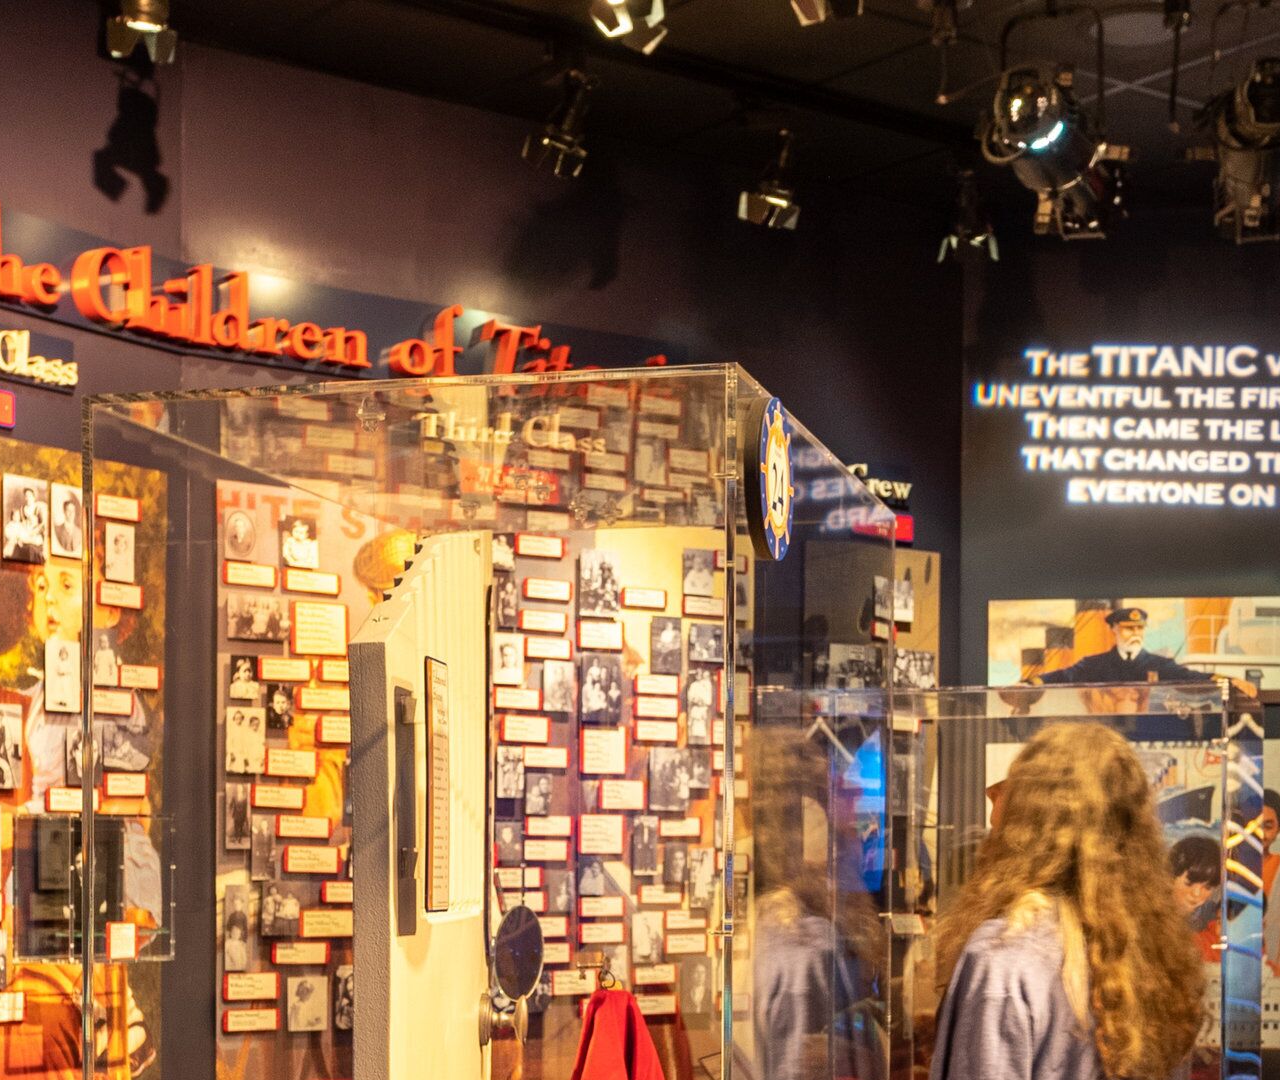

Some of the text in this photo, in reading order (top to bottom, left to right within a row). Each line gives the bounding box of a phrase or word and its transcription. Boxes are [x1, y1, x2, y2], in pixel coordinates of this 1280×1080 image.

[71, 225, 371, 369] Children
[388, 303, 464, 376] of
[1091, 344, 1259, 379] TITANIC
[975, 382, 1172, 409] UNEVENTFUL
[1175, 386, 1236, 409] THE
[1113, 417, 1200, 441] CAME
[1203, 418, 1265, 442] THE
[1022, 446, 1102, 472] THAT
[1103, 448, 1252, 474] CHANGED
[1067, 476, 1226, 506] EVERYONE
[1228, 482, 1277, 508] ON
